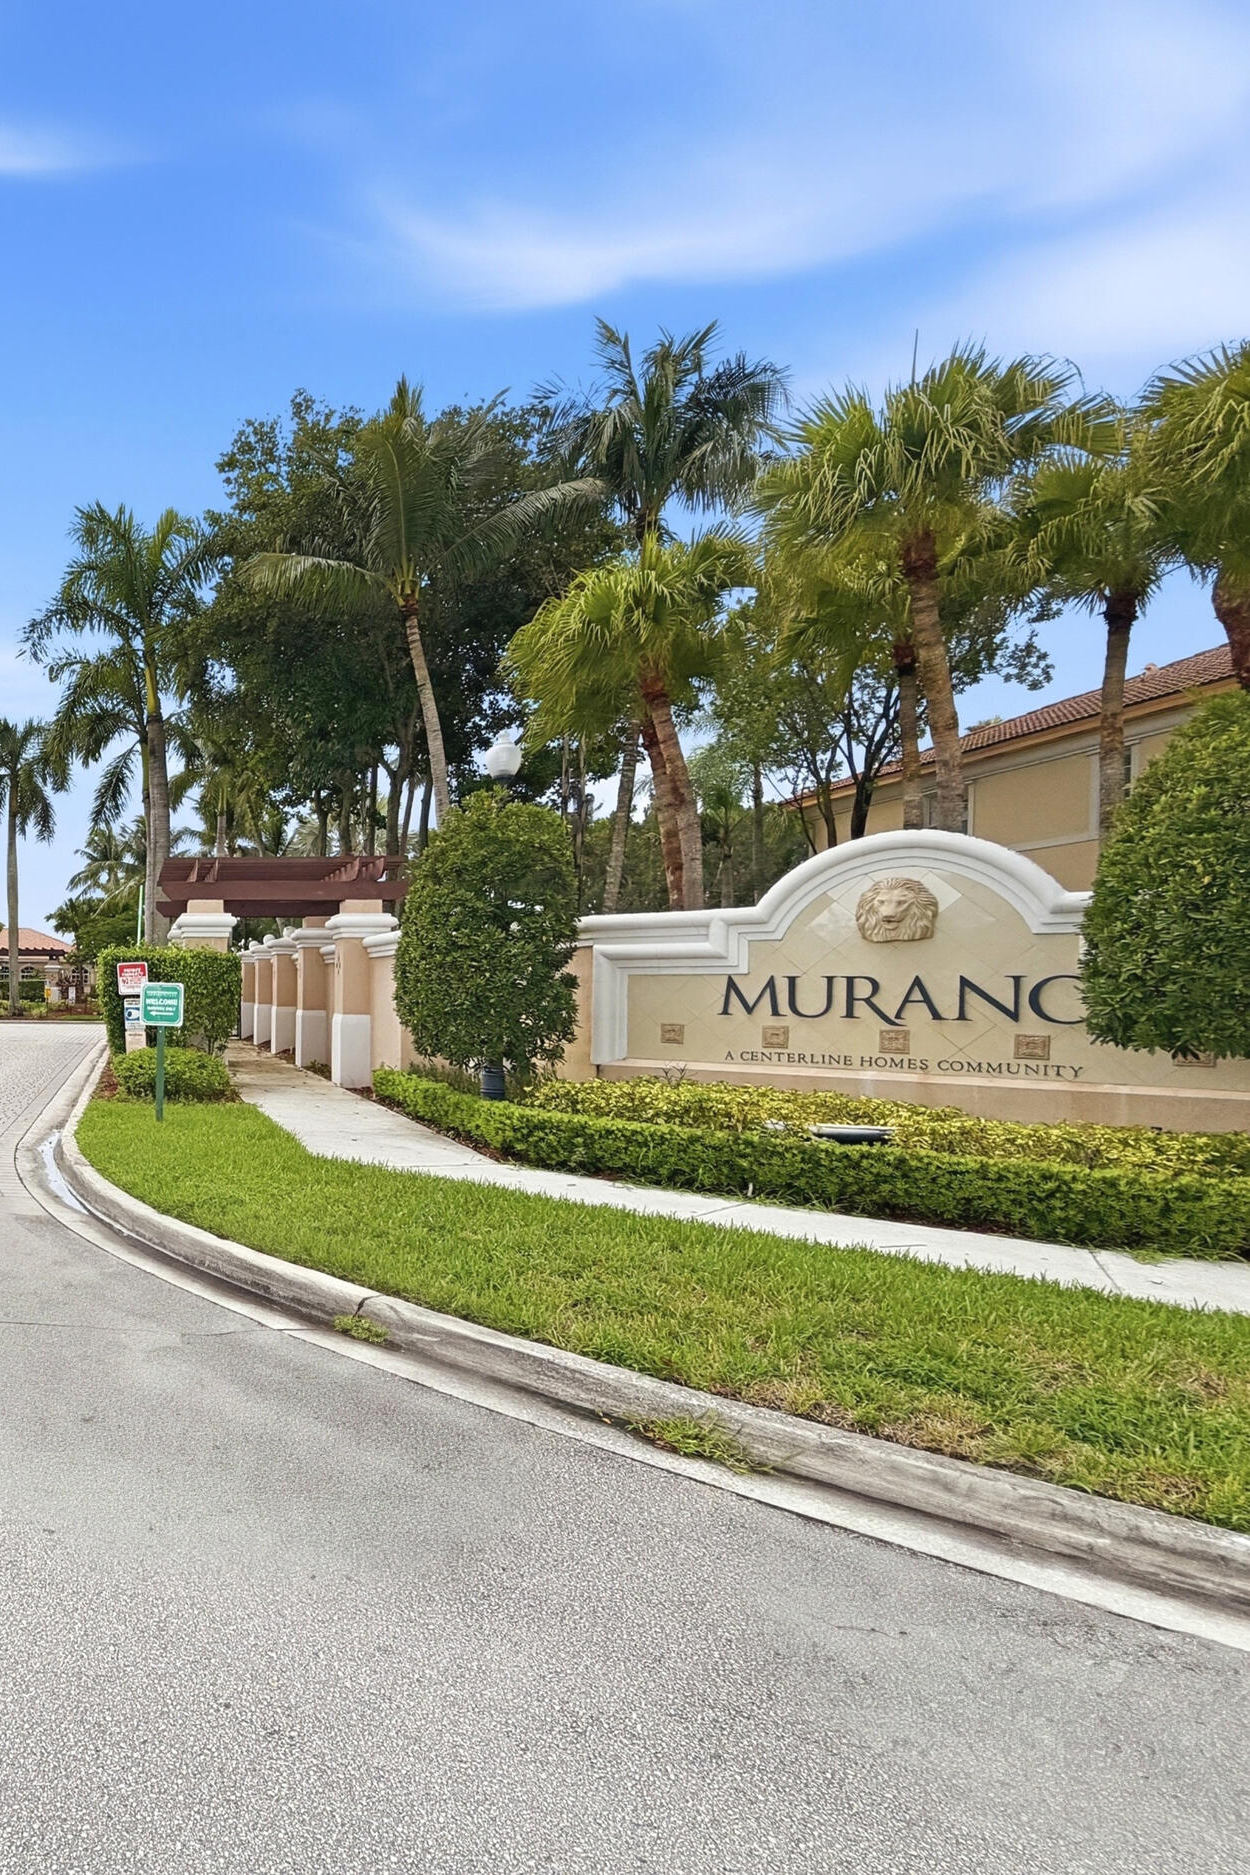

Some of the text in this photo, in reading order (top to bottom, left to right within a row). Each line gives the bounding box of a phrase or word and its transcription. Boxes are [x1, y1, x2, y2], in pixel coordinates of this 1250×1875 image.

[146, 998, 178, 1006] WELCOME
[724, 1050, 1084, 1079] A CENTERLINE HOMES COMMUNITY
